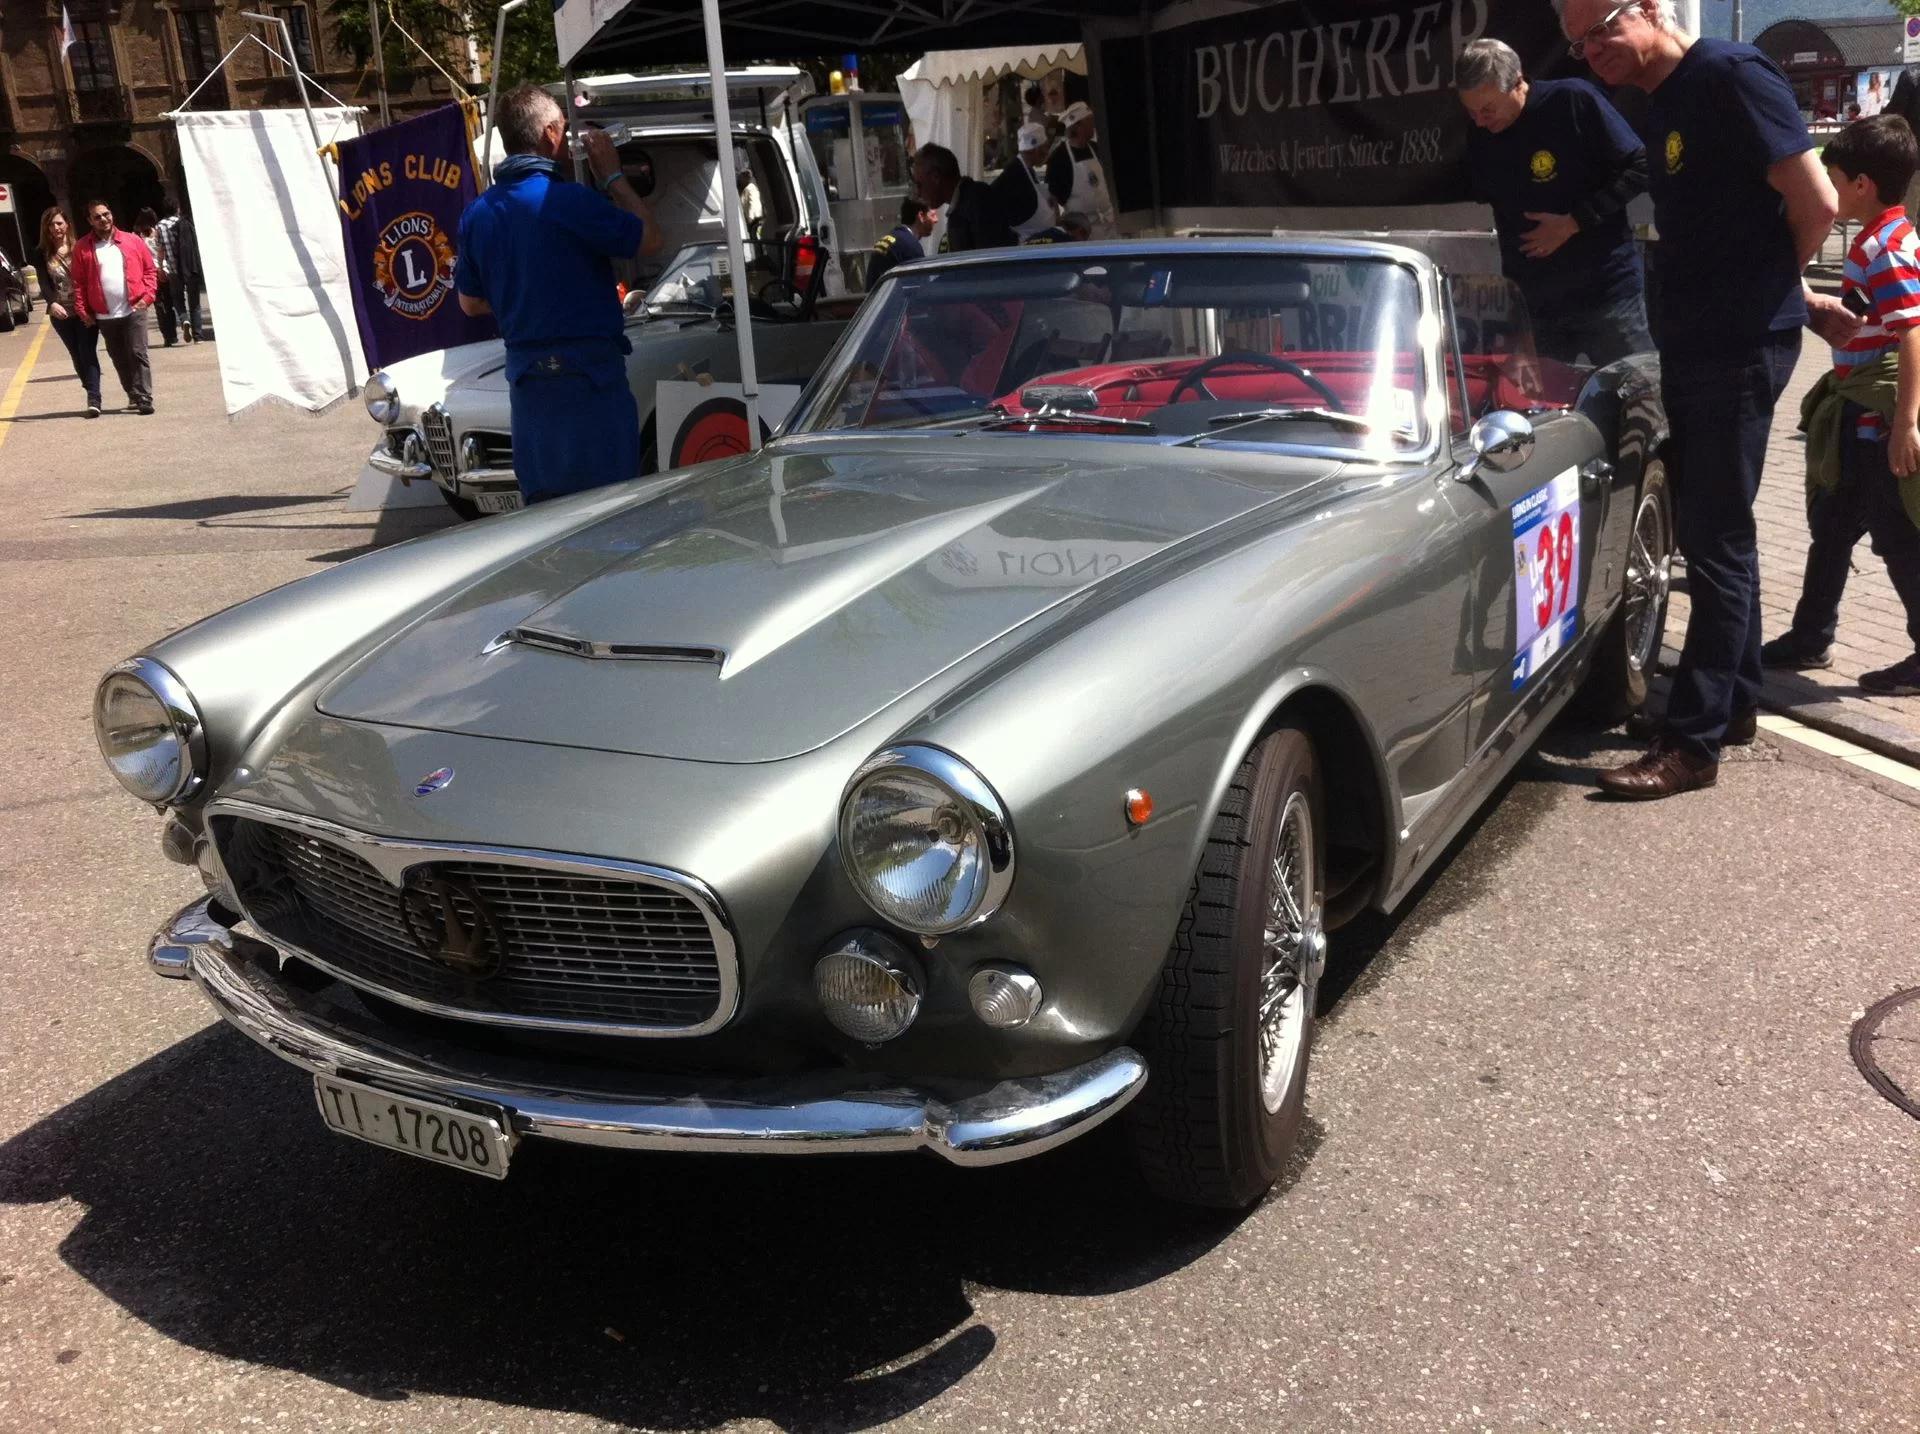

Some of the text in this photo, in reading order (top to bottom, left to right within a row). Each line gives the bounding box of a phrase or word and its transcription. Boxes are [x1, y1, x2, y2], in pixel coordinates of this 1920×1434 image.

[1219, 140, 1278, 175] Watches
[1280, 140, 1289, 169] &
[1348, 133, 1393, 169] Since
[340, 154, 461, 220] LIONS CLUB
[385, 217, 430, 246] LIONS
[402, 249, 427, 288] L
[394, 284, 446, 313] INTERNATIONAL
[1537, 512, 1573, 631] 39
[387, 1103, 490, 1167] 17208
